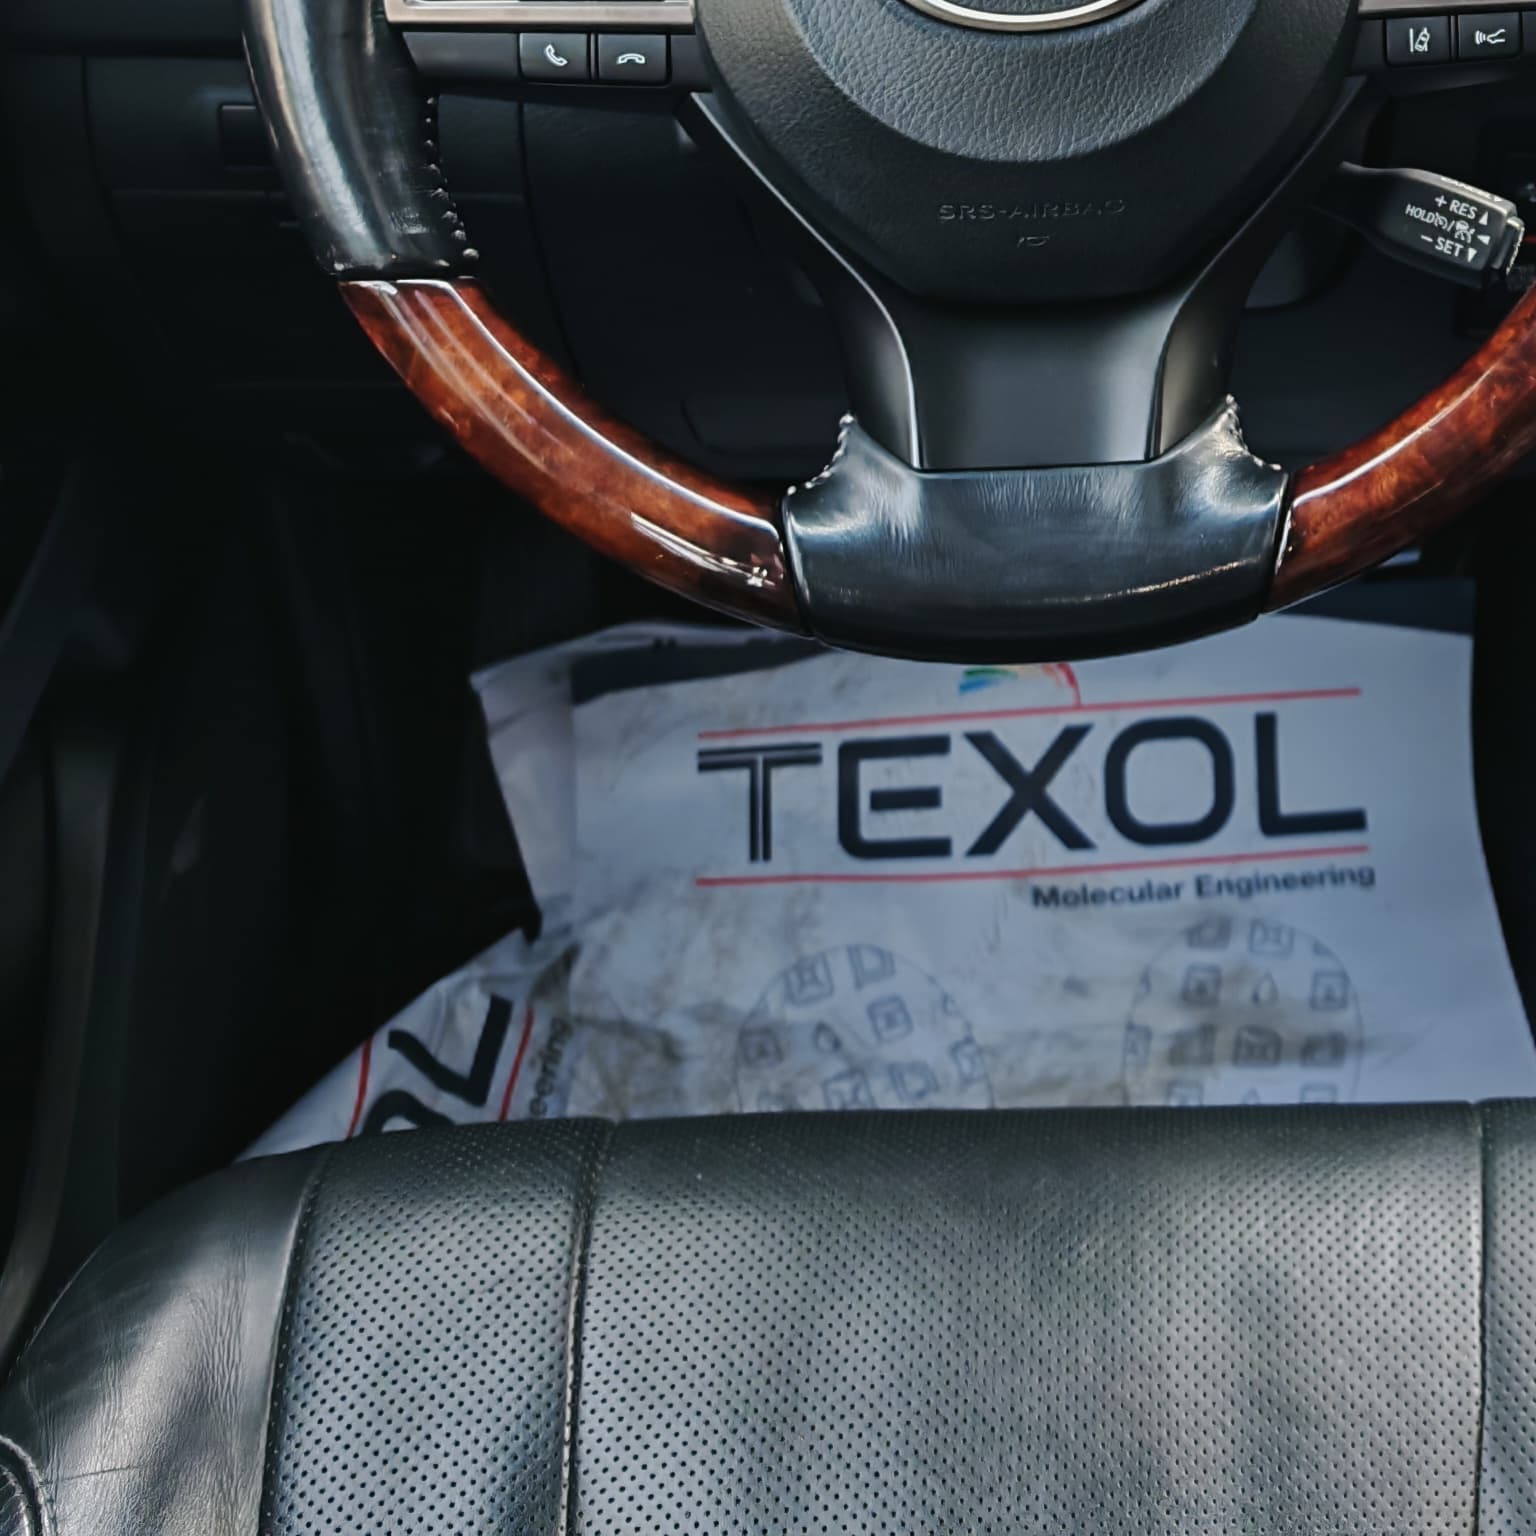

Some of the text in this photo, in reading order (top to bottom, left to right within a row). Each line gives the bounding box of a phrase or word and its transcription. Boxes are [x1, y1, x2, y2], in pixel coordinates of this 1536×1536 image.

[1405, 204, 1435, 225] HOLD
[697, 712, 1368, 862] TEXOL
[1031, 865, 1376, 908] Molecular Engineering
